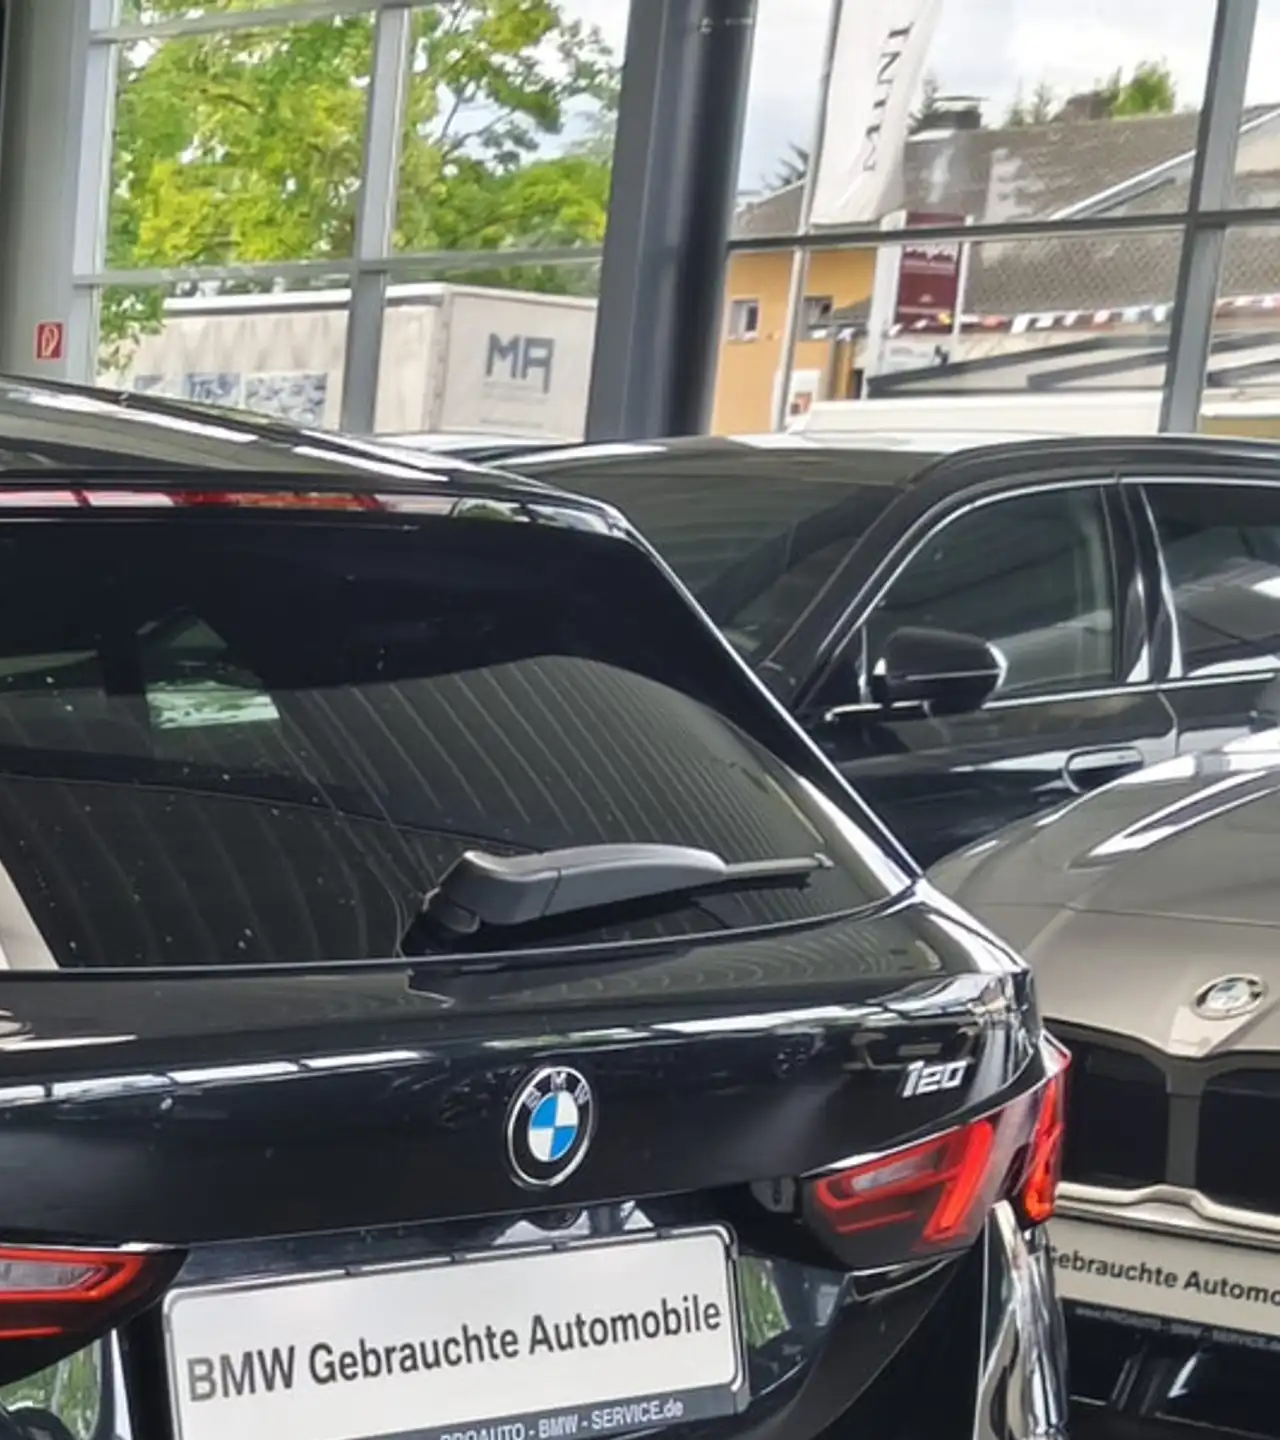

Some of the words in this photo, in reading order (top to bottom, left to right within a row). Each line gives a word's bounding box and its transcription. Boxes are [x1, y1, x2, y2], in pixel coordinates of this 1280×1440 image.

[902, 1060, 968, 1098] 120
[187, 1345, 295, 1402] BMW
[309, 1322, 520, 1386] Gebrauchte
[528, 1294, 721, 1355] Automobile
[539, 1413, 579, 1438] BMW
[591, 1398, 683, 1429] SERVICE.de
